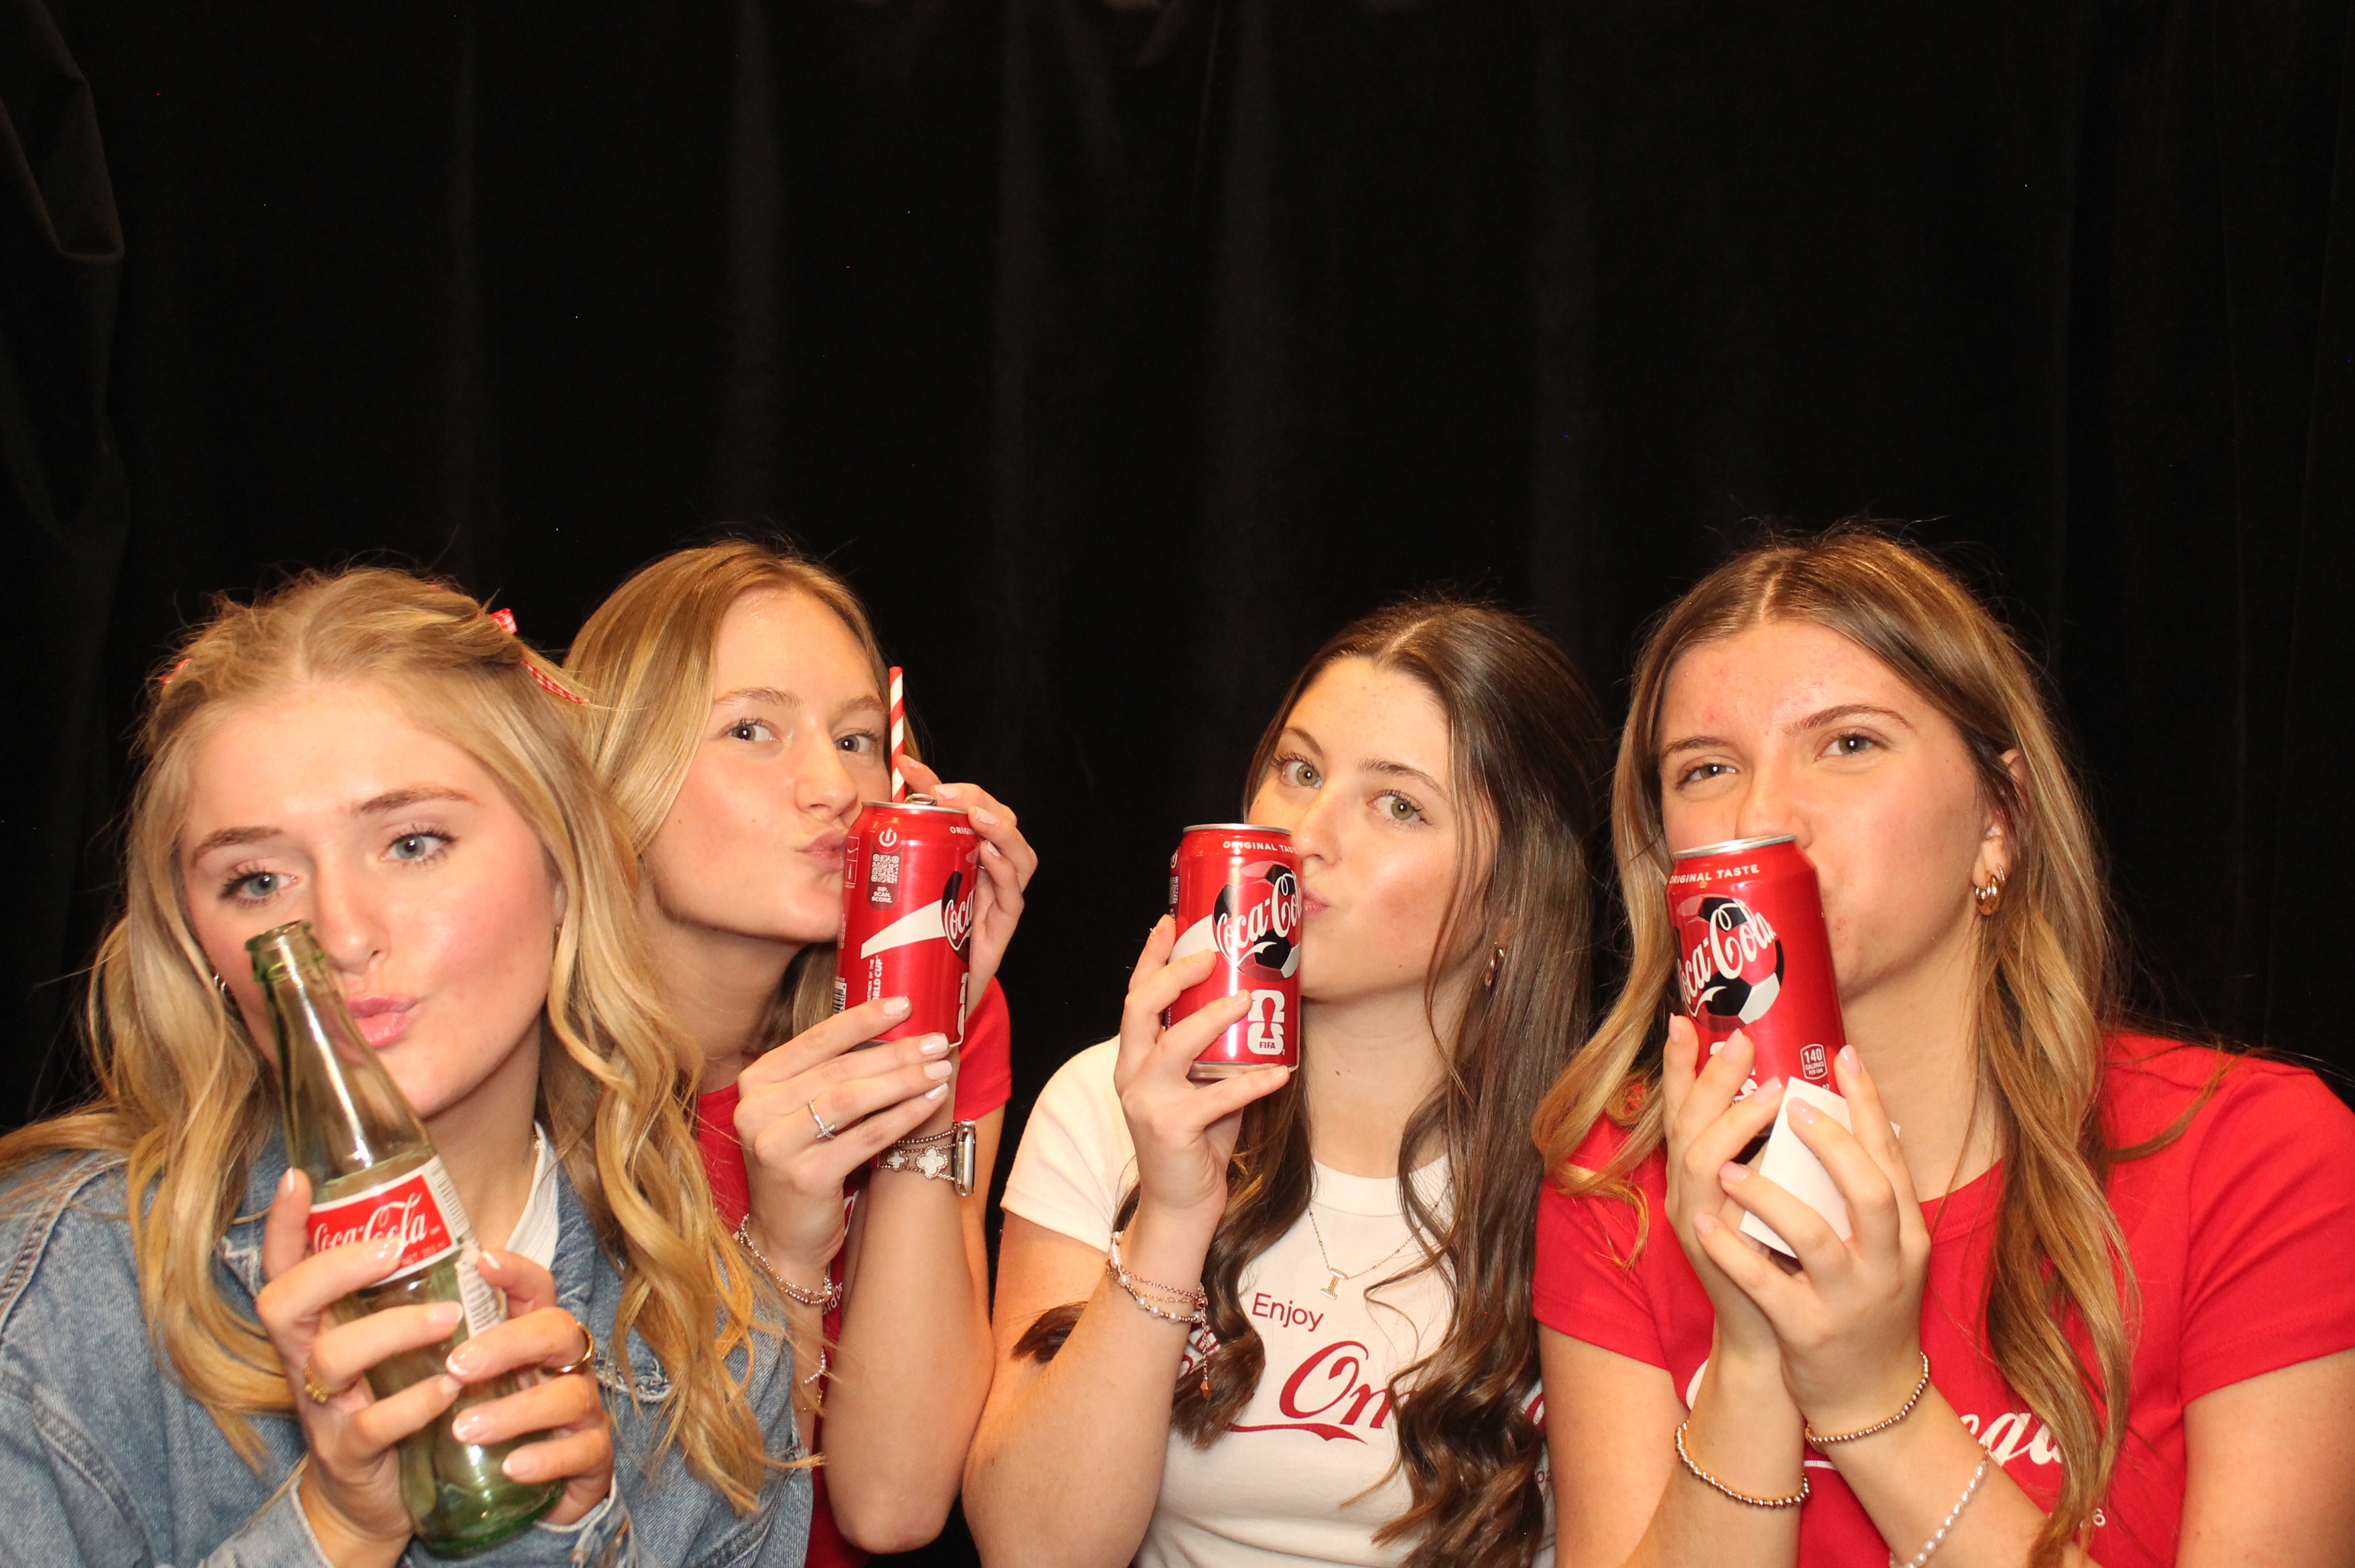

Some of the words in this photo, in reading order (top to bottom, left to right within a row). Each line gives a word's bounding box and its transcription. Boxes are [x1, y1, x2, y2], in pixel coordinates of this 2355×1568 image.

[1222, 840, 1278, 851] ORIGINAL
[1279, 844, 1298, 854] TAST
[1716, 864, 1760, 879] TASTE
[869, 971, 873, 979] OF
[1259, 1041, 1276, 1049] FIFA
[1804, 1048, 1823, 1063] 140
[1251, 1292, 1324, 1332] Enjoy
